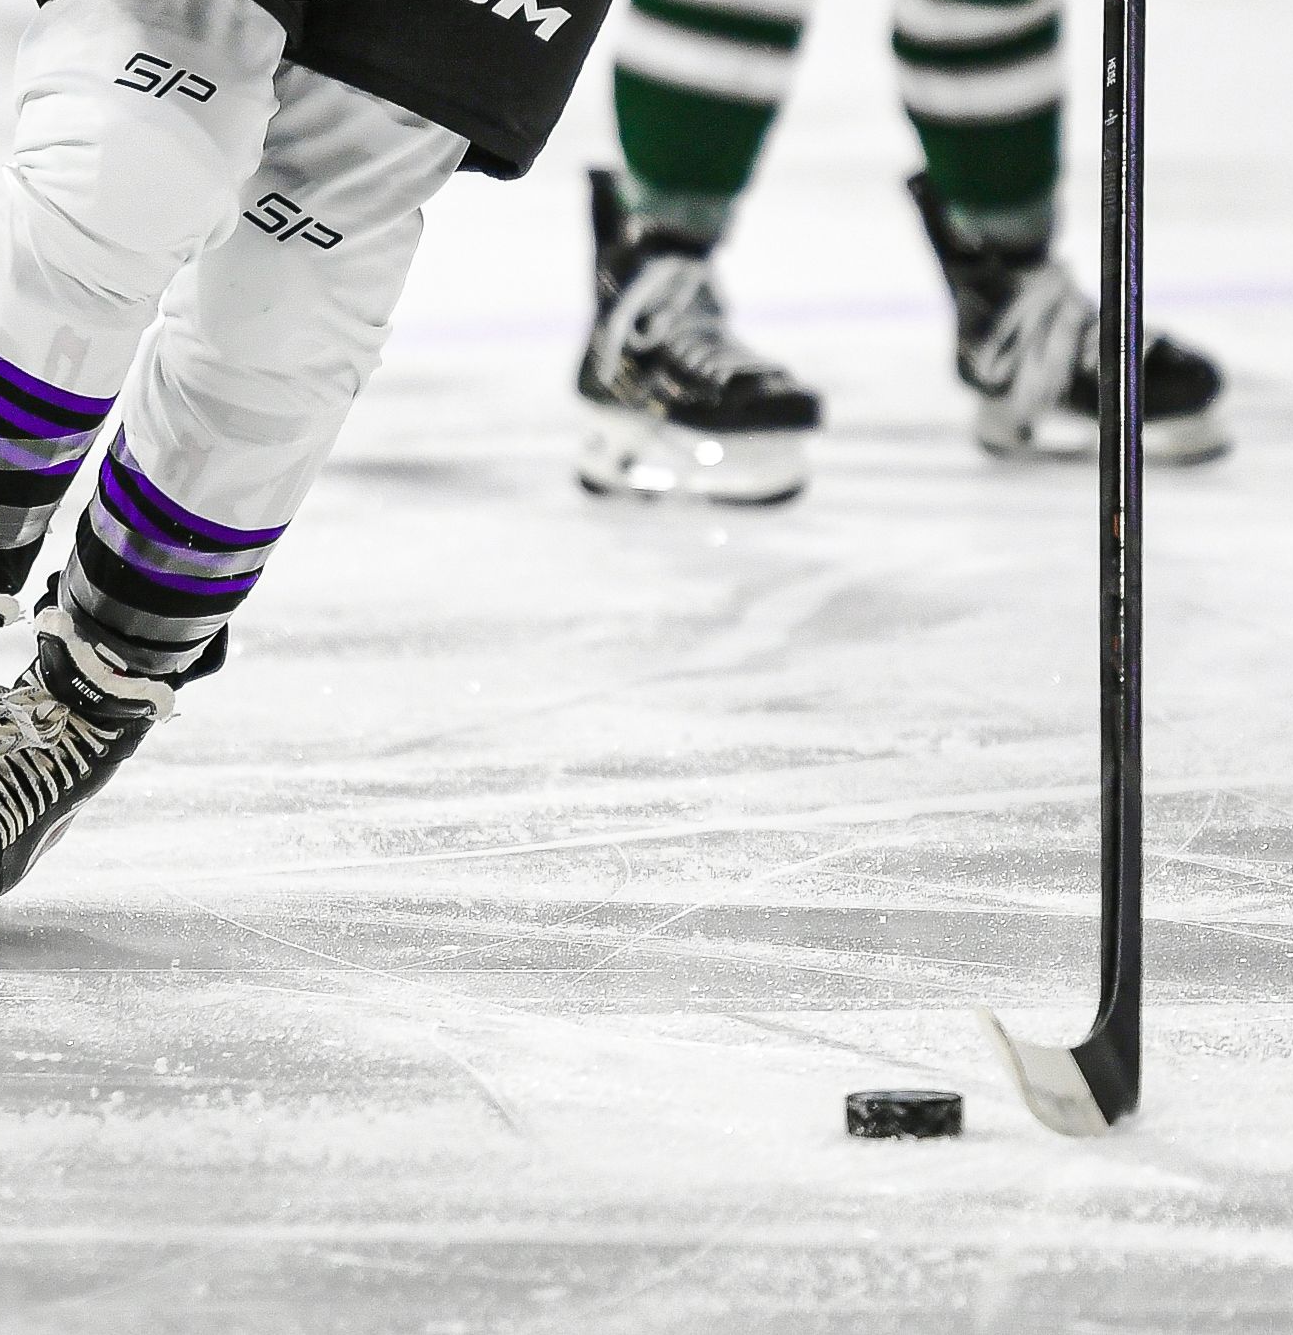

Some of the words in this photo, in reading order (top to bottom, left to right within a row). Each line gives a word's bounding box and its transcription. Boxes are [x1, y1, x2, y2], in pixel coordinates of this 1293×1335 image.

[113, 52, 218, 103] SP
[242, 192, 344, 250] SP
[71, 677, 104, 704] HEISE
